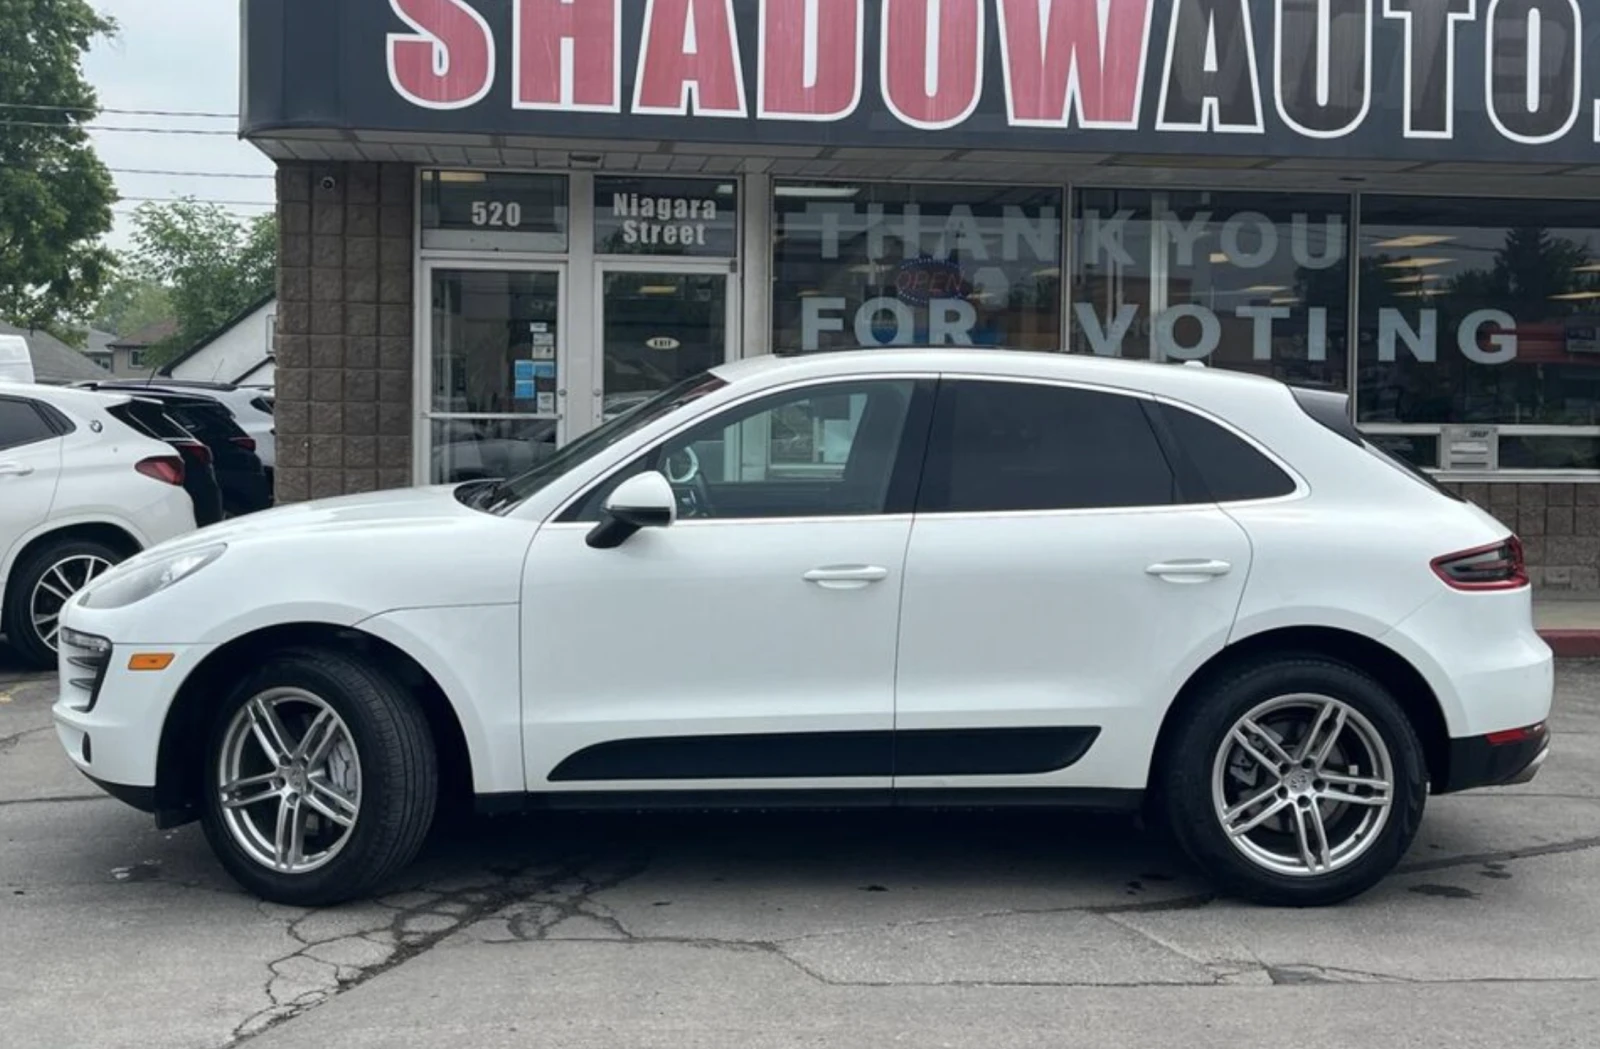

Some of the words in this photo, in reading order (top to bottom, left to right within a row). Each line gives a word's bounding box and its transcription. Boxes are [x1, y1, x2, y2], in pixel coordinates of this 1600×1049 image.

[386, 0, 1600, 143] SHADOWAUTO
[471, 201, 521, 226] 520
[613, 193, 717, 221] Niagara
[622, 221, 706, 245] Street
[894, 268, 966, 293] OPEN
[801, 296, 978, 351] FOR
[1073, 301, 1518, 364] VOTING
